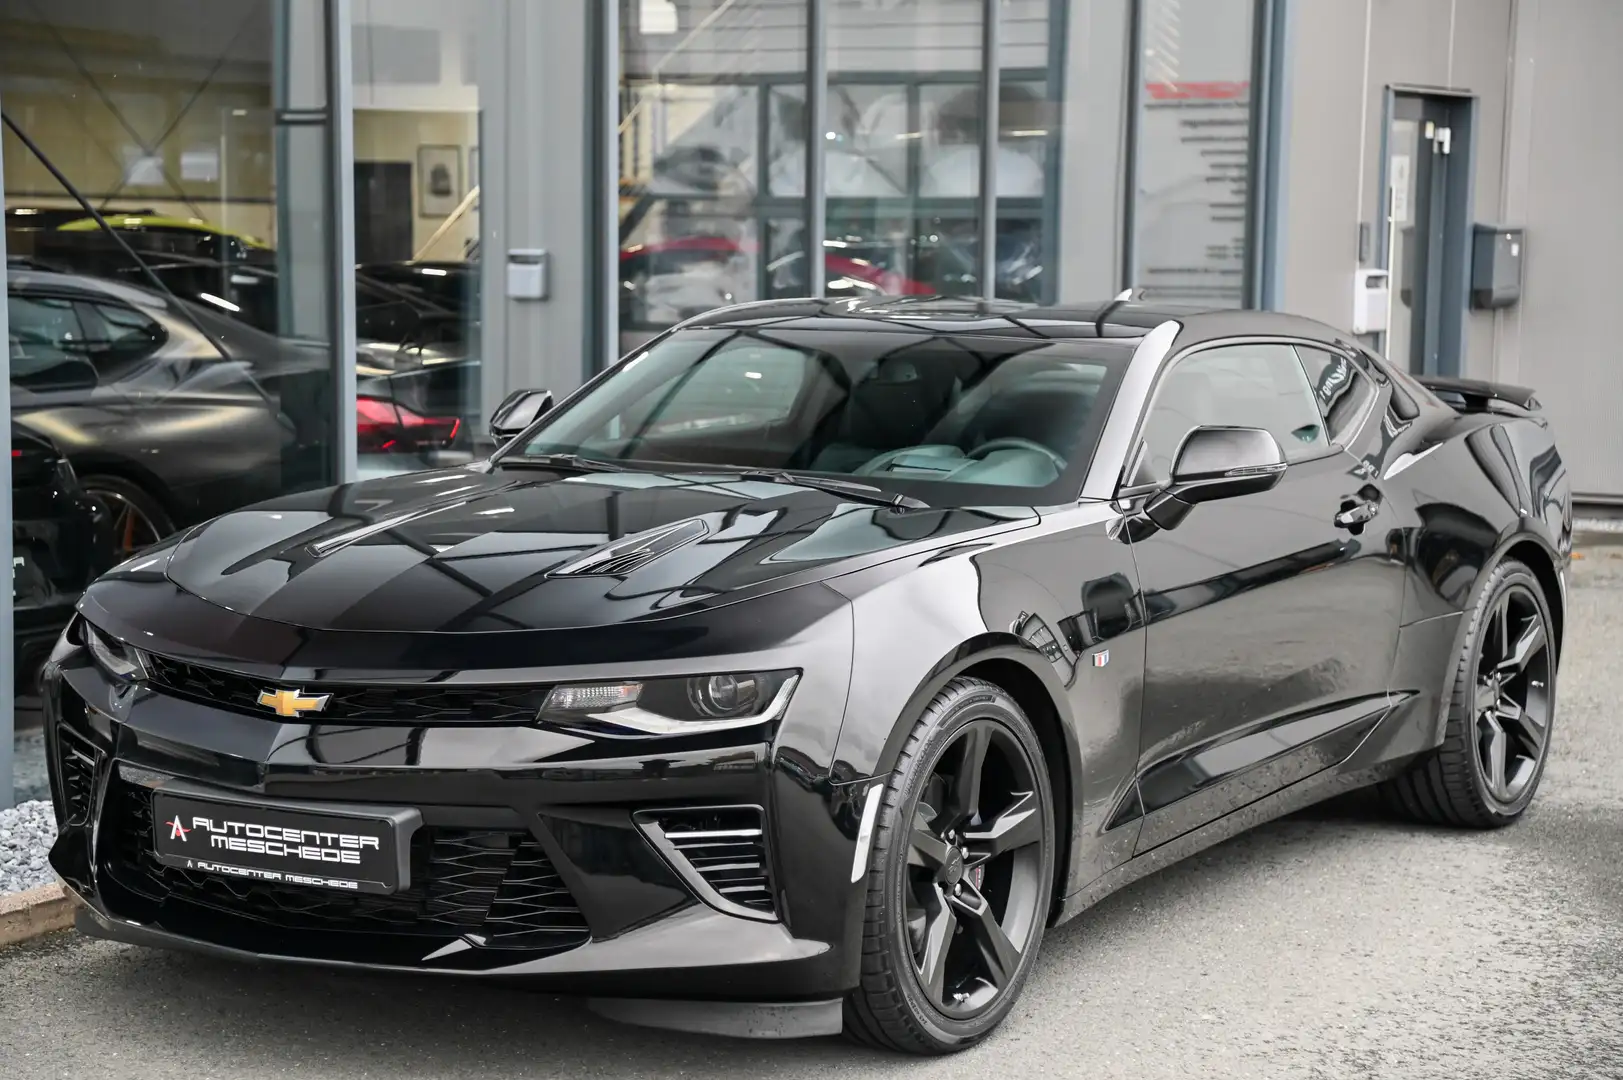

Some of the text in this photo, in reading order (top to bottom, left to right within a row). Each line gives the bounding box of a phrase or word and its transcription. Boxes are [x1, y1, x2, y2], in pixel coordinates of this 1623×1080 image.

[192, 816, 380, 851] AUTOCENTER
[210, 835, 361, 865] MESCHEDE
[197, 861, 282, 881] AUTOCENTER
[285, 874, 359, 890] MESCHEDE
